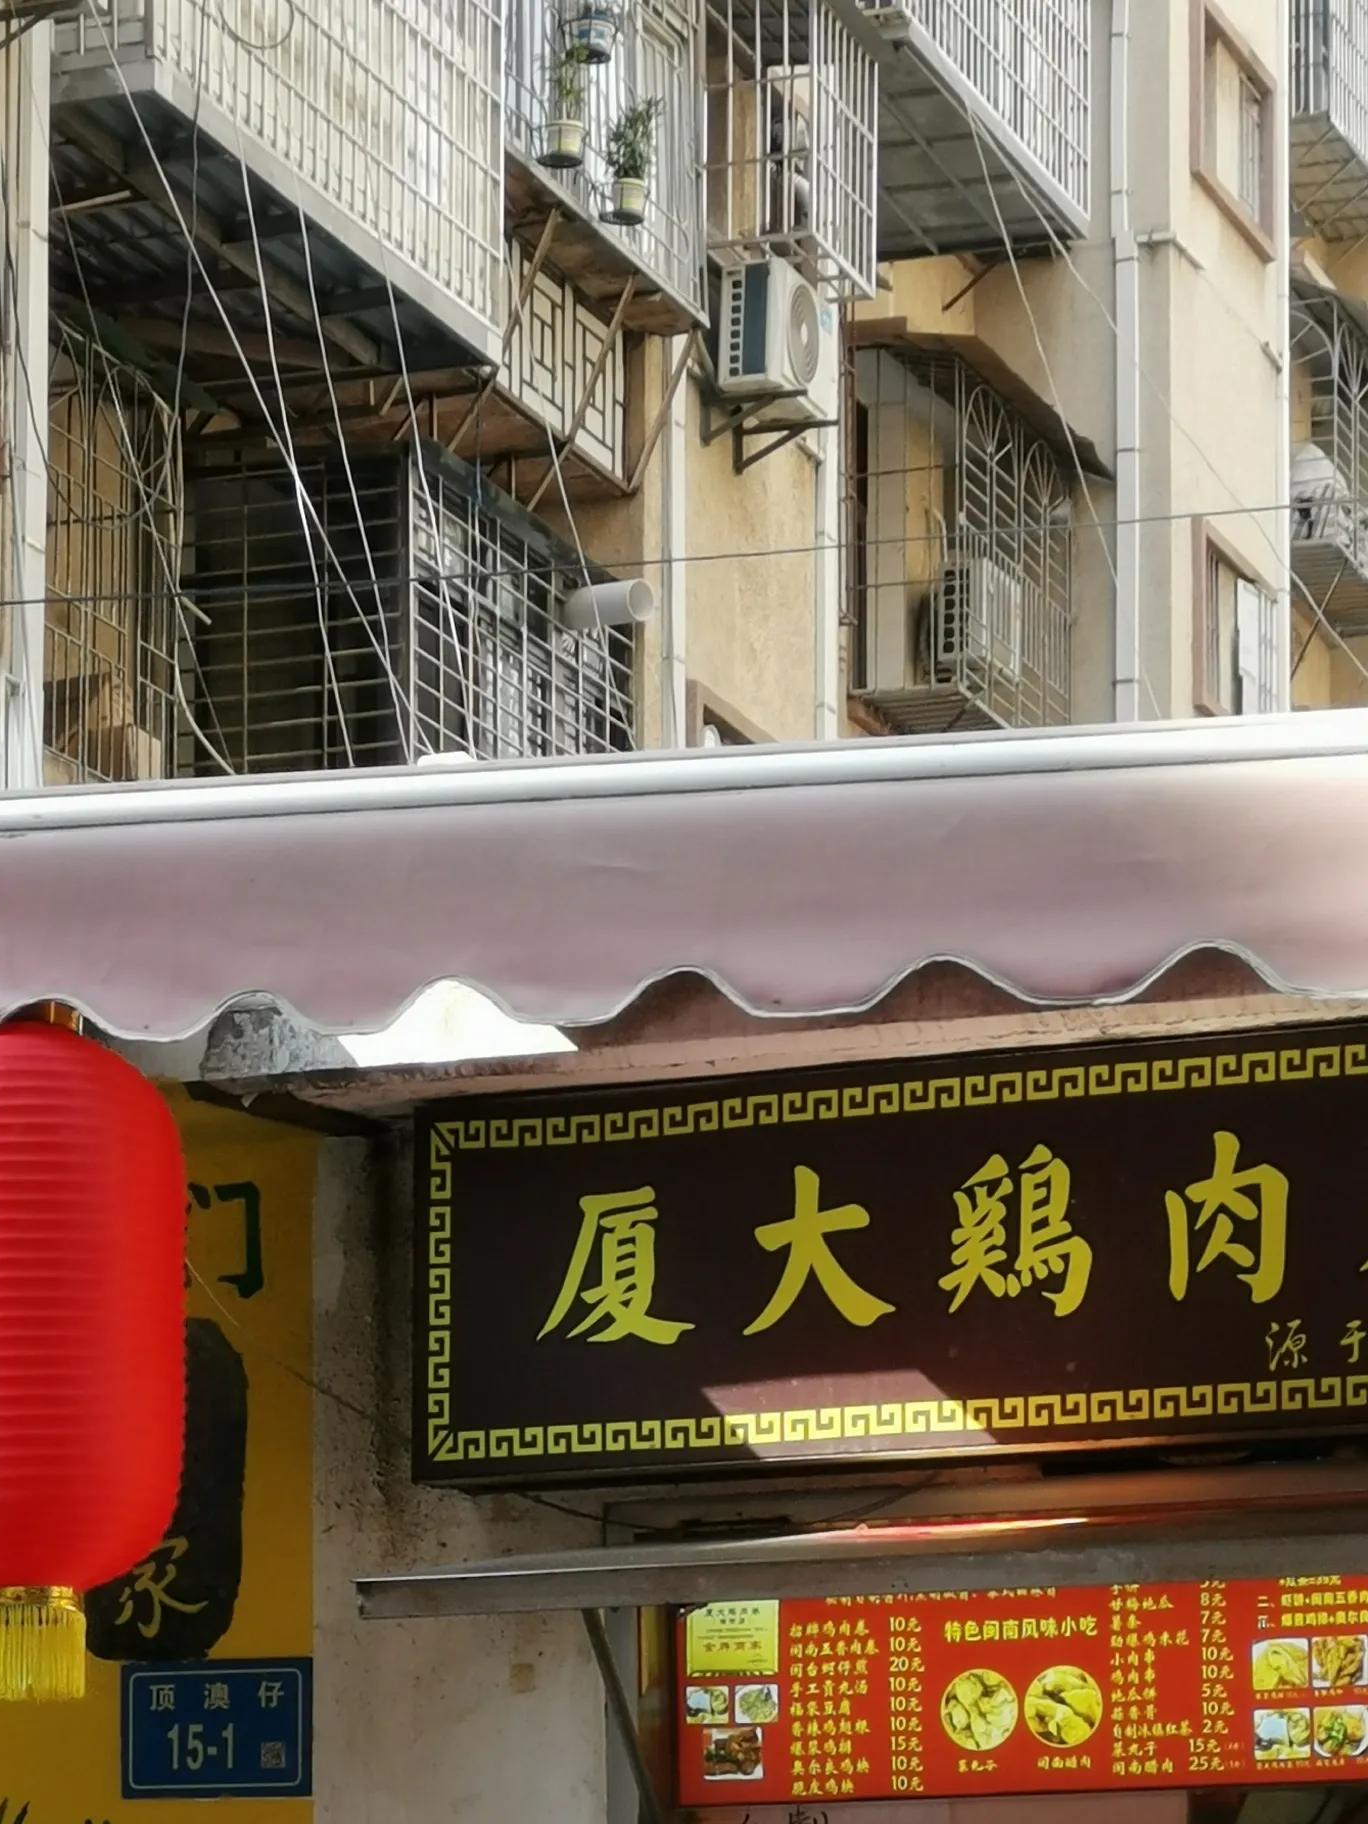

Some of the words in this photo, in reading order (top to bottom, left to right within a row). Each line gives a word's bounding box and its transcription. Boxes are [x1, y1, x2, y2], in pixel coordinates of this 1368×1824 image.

[944, 1614, 1098, 1643] 特色闽南风味小吃
[149, 1681, 284, 1711] 顶澳仔
[167, 1723, 234, 1771] 15-1
